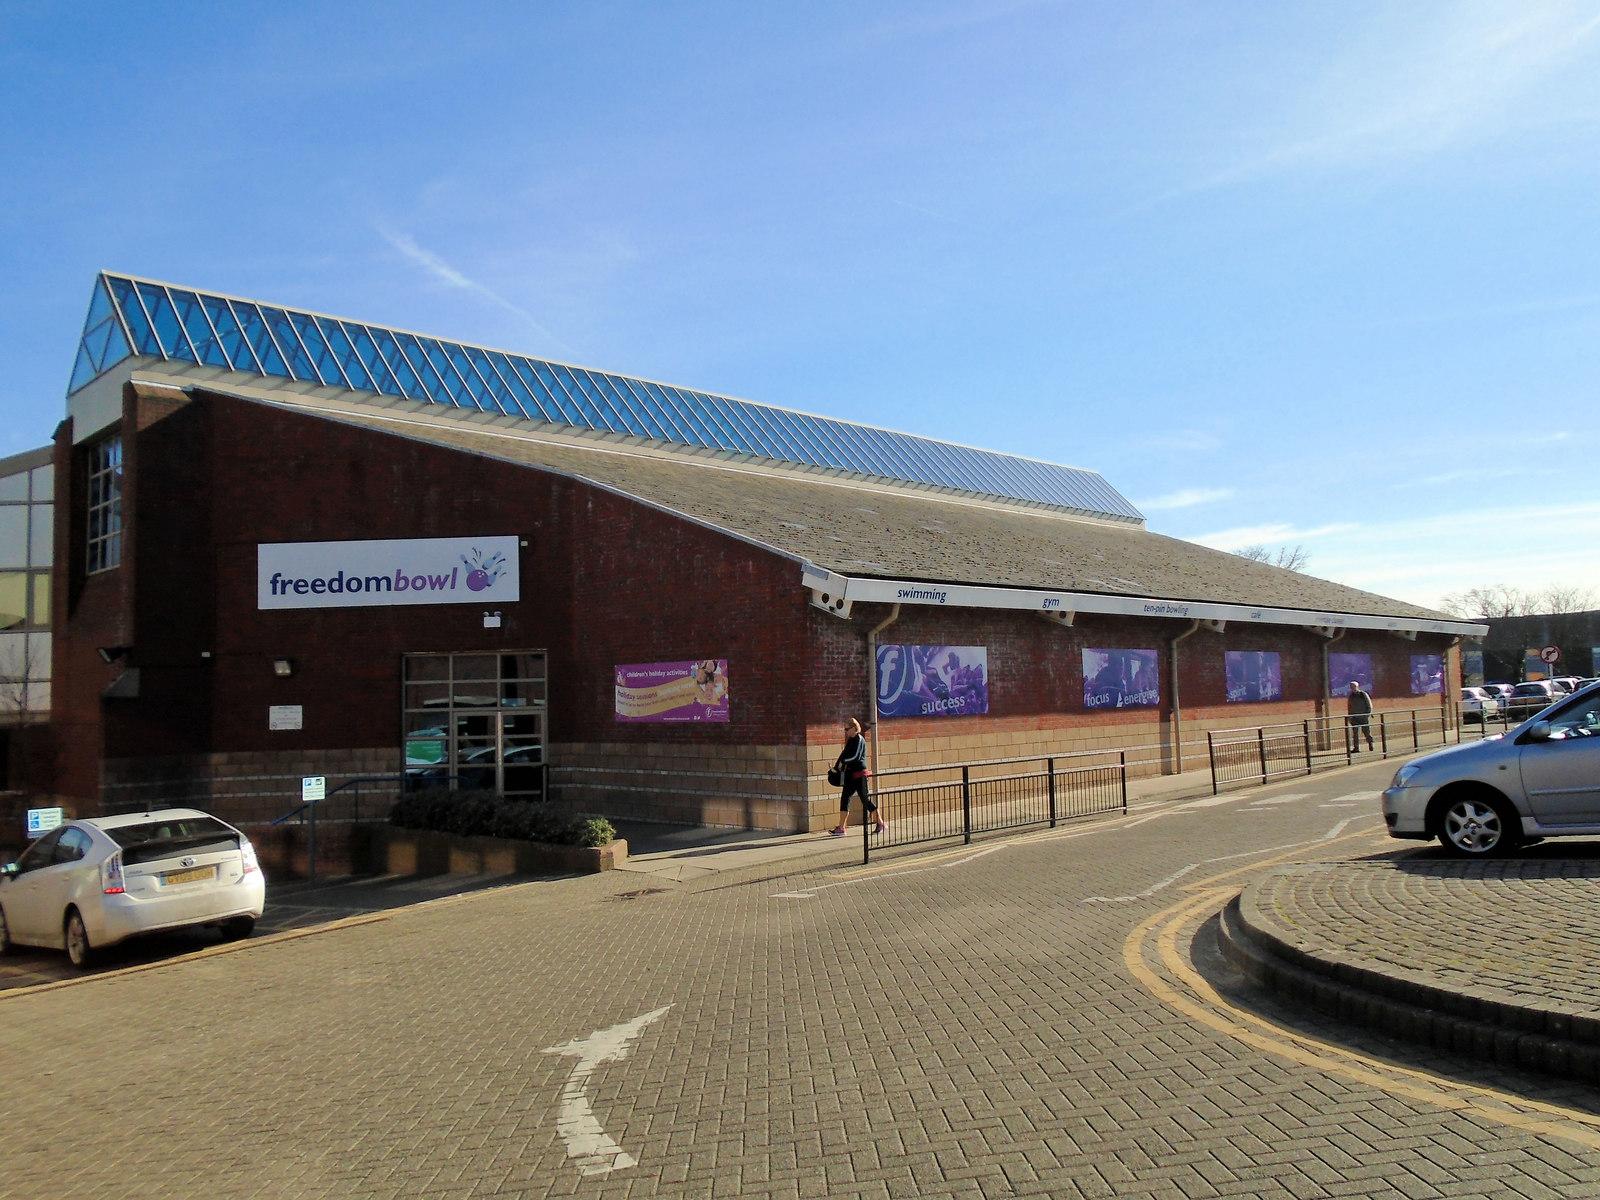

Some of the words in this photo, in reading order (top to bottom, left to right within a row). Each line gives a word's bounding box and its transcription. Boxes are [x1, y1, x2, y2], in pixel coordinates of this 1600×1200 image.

[270, 567, 458, 595] freedombowl
[897, 587, 947, 604] swimming
[1042, 597, 1060, 608] gym
[1143, 604, 1165, 615] ten-pin
[1166, 605, 1188, 616] bowling
[921, 695, 966, 715] success
[1087, 692, 1109, 706] focus
[1124, 687, 1157, 704] energise
